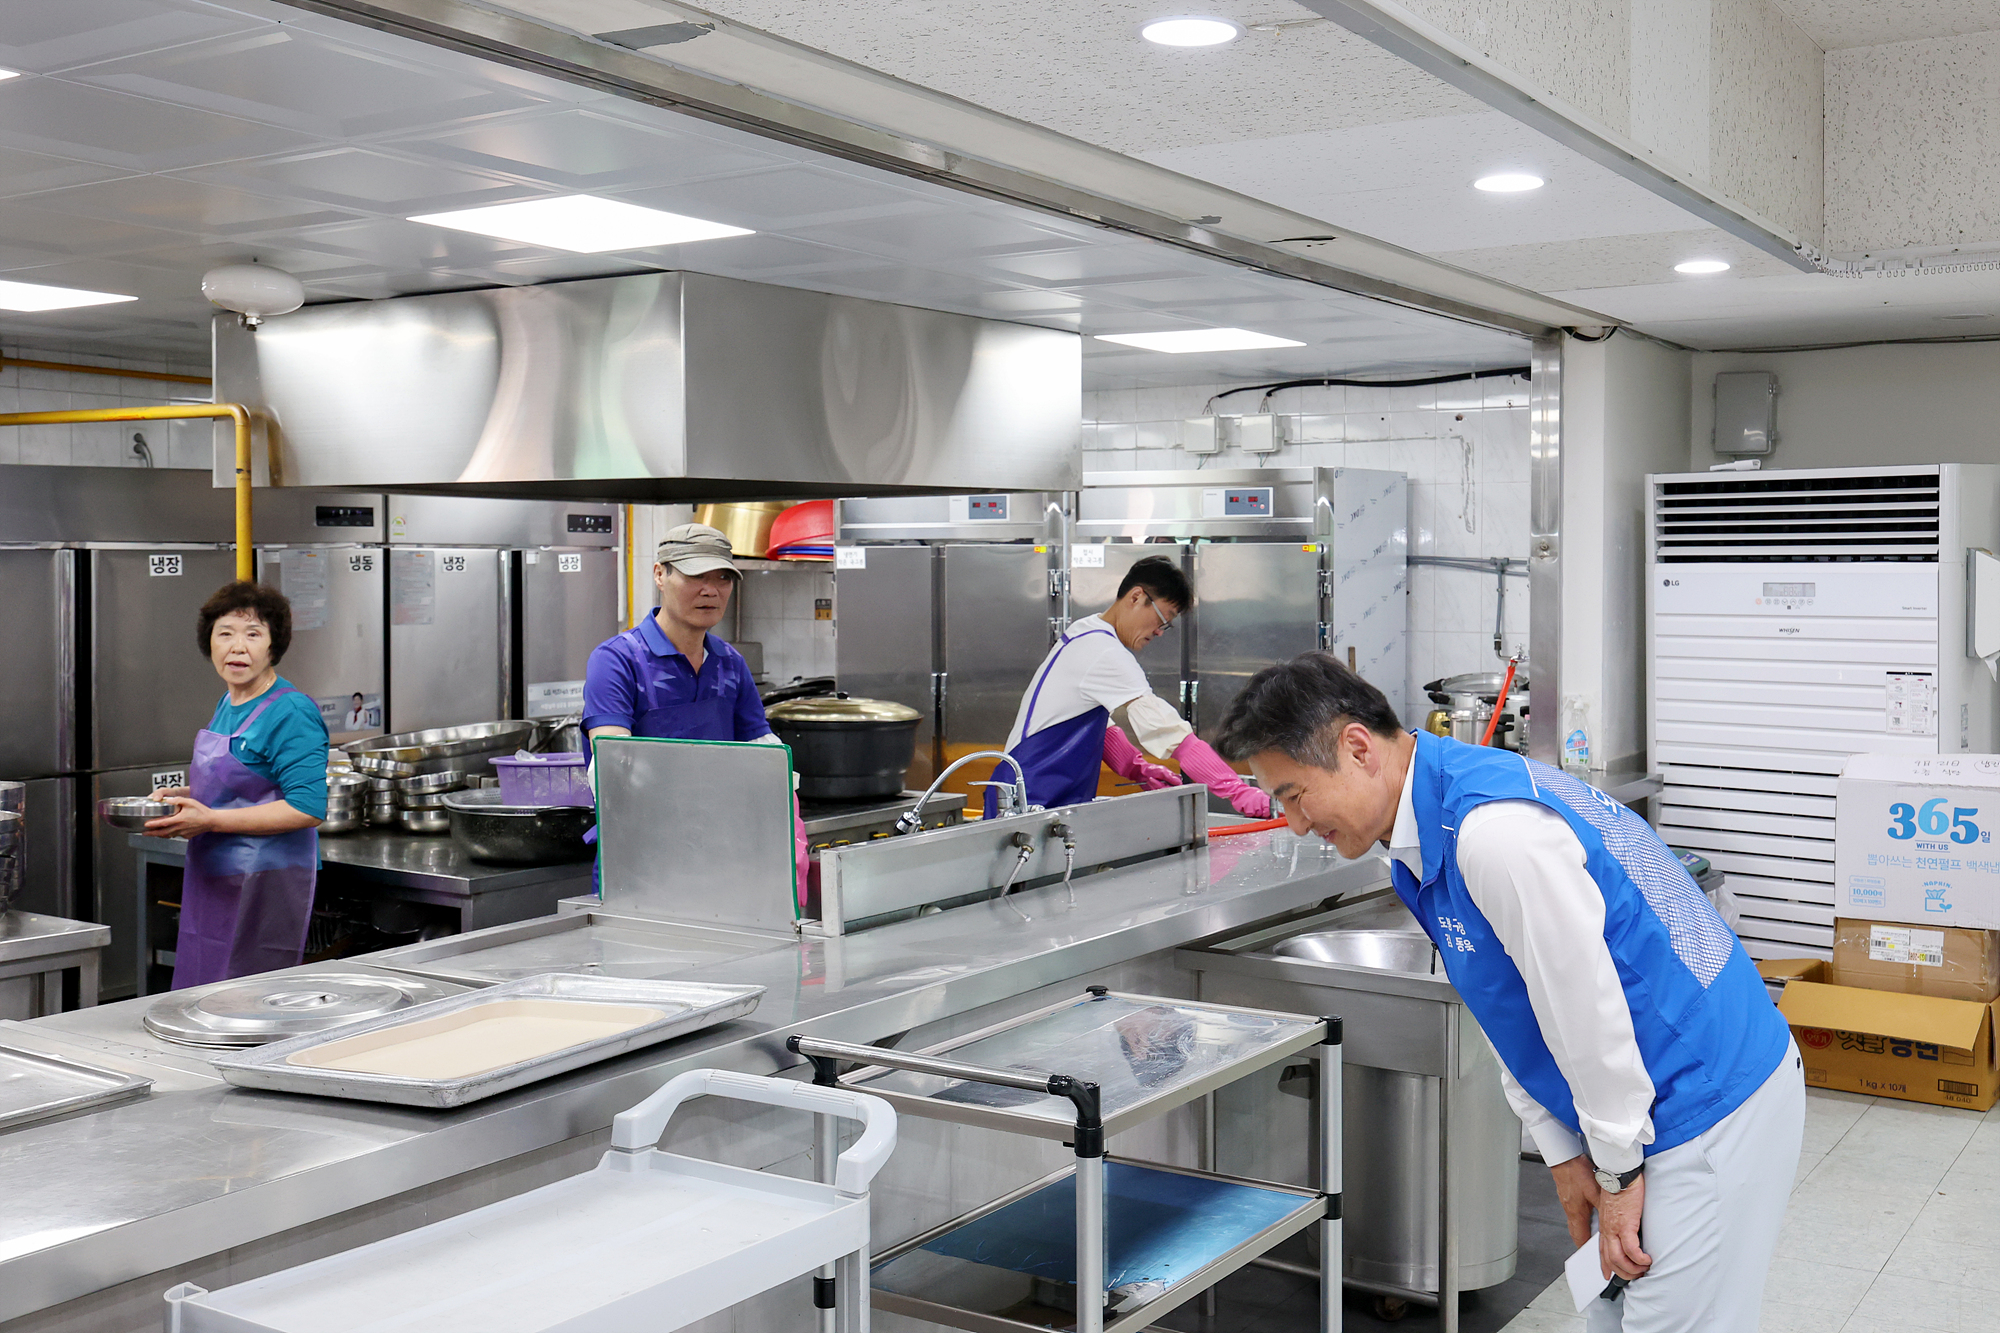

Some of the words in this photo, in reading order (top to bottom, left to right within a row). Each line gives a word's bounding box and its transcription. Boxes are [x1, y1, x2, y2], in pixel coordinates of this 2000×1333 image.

[151, 556, 180, 574] 냉장
[349, 555, 374, 572] 냉동
[443, 555, 465, 572] 냉장
[559, 555, 580, 571] 냉장
[1916, 842, 1935, 850] WITH
[1867, 853, 1913, 868] 뽑아쓰는
[1915, 856, 1962, 871] 천연펄프
[1923, 880, 1950, 889] NAPKIN
[1866, 1080, 1878, 1090] kg
[1889, 1083, 1907, 1093] 10개
